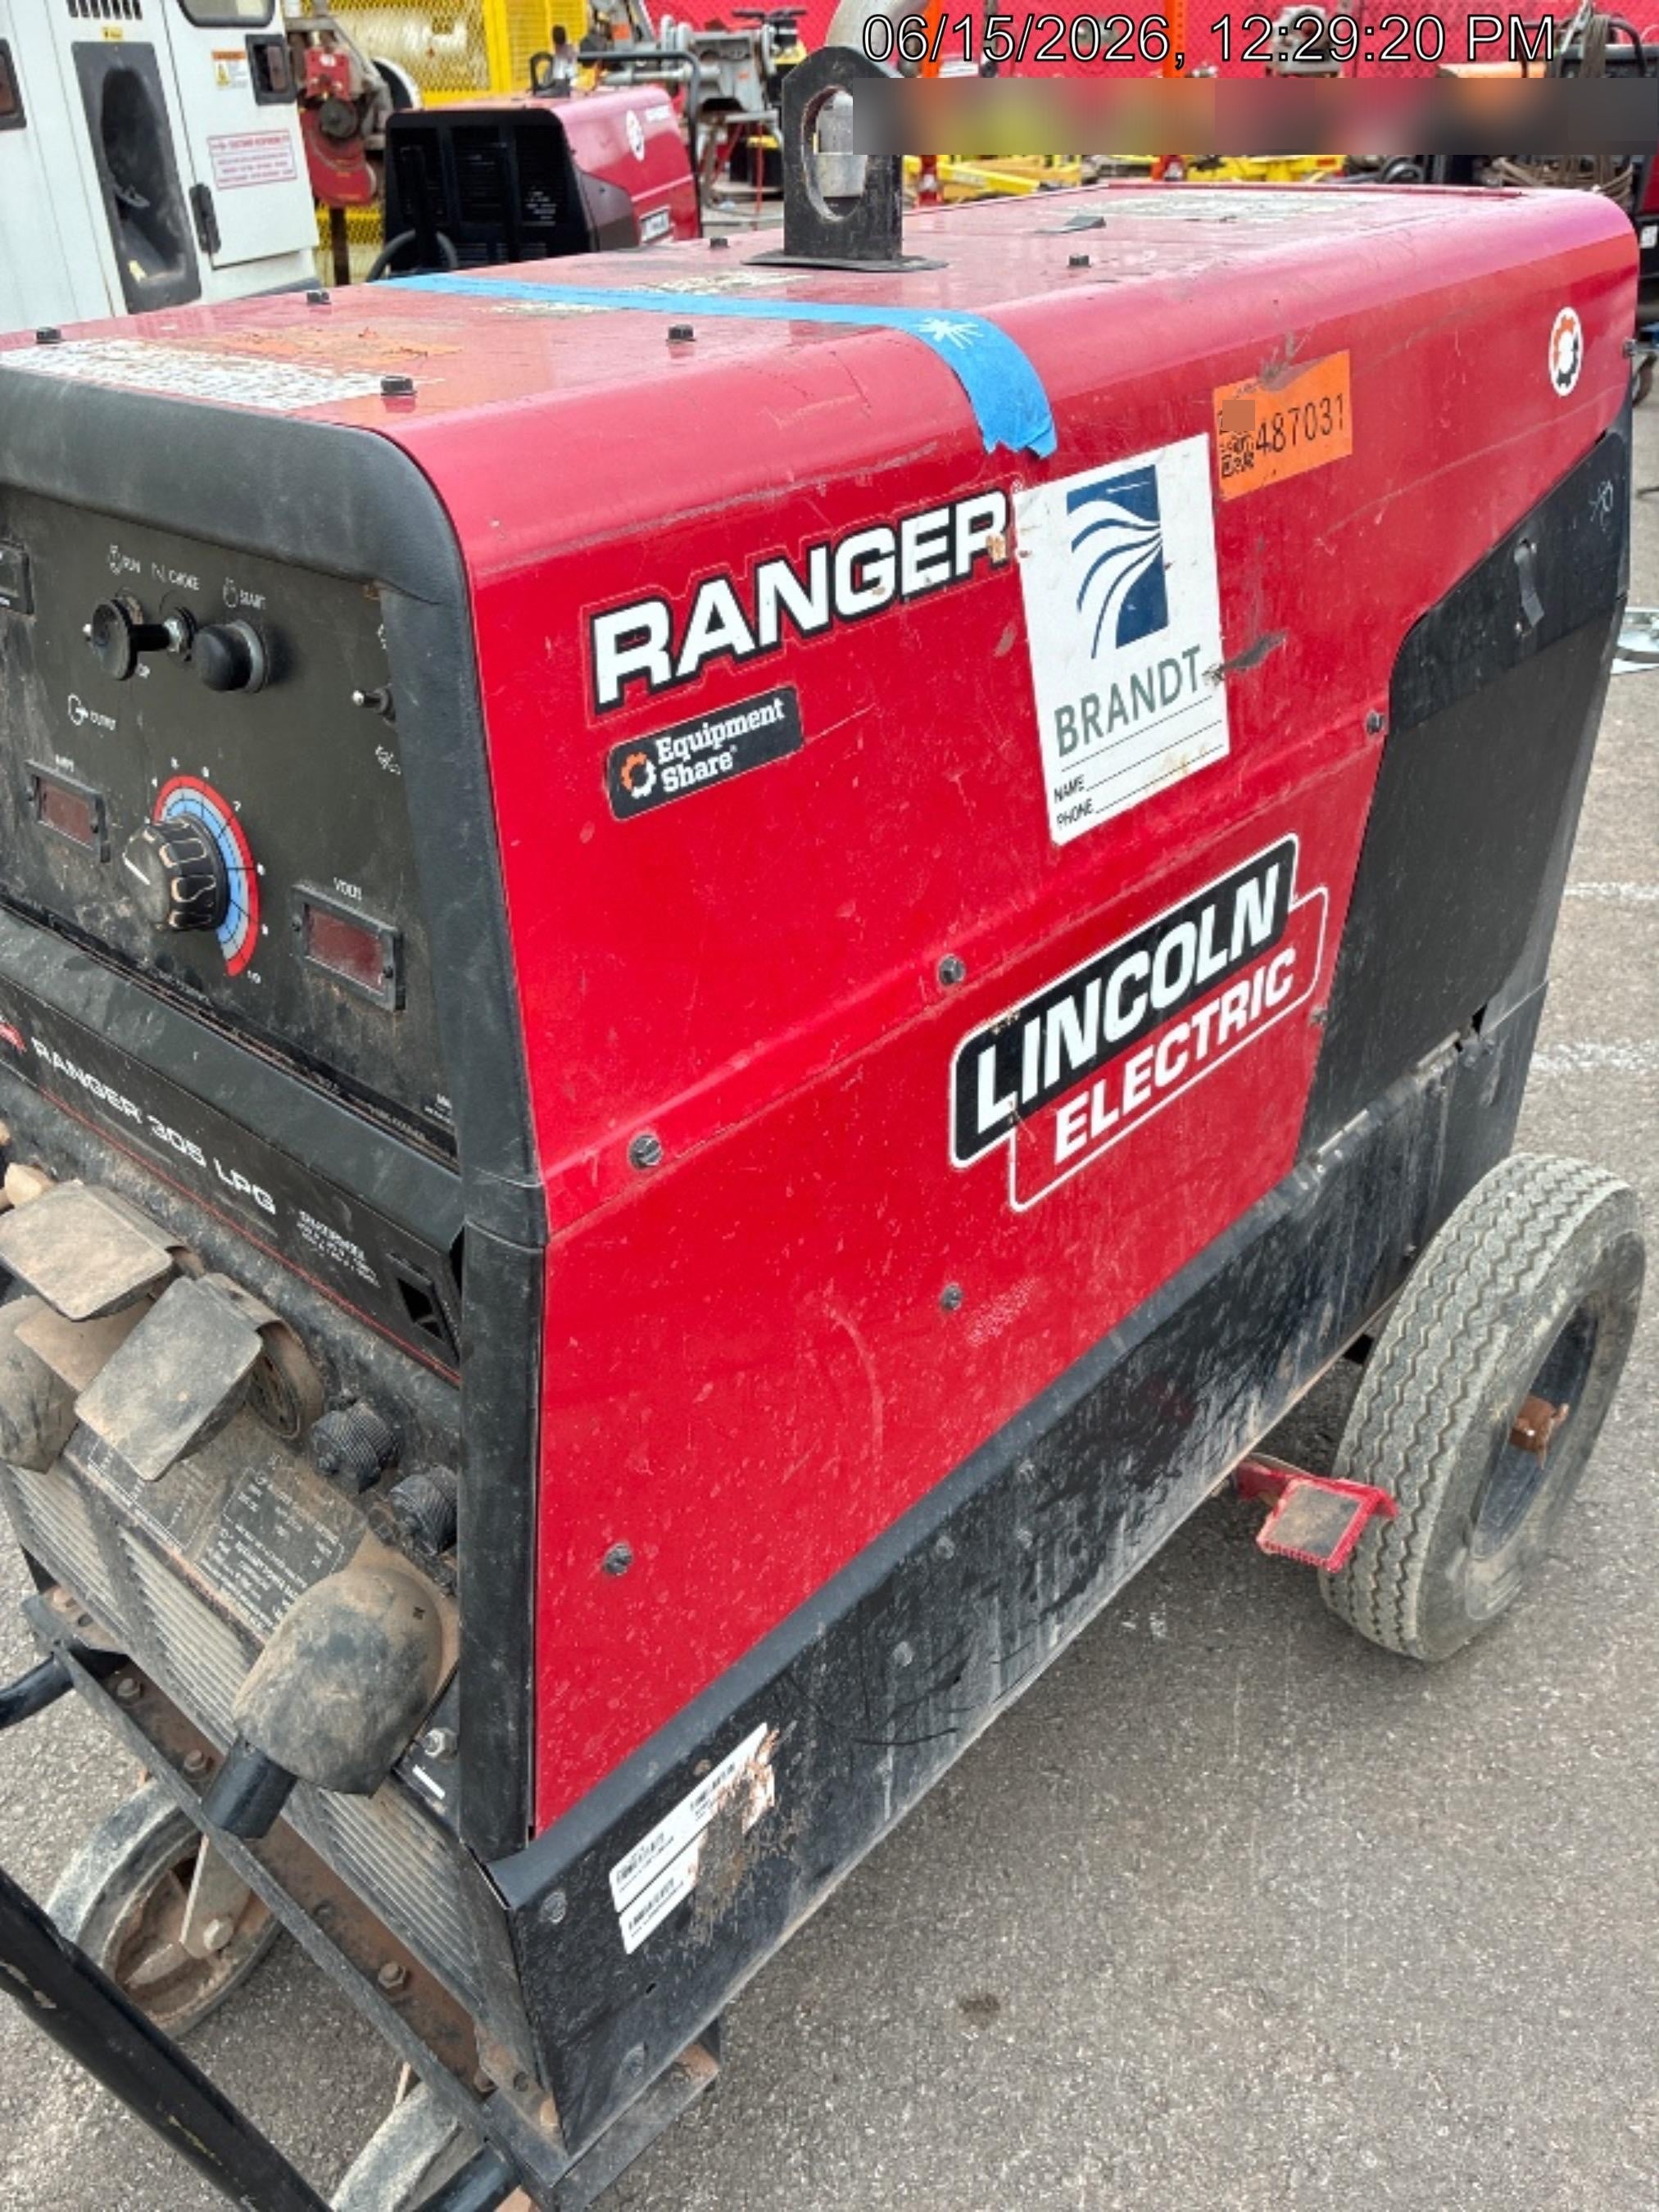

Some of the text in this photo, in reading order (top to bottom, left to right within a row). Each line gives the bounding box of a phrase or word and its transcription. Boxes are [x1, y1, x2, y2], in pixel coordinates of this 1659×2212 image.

[592, 490, 1009, 713] RANGER
[655, 697, 786, 765] Equipment
[1054, 645, 1202, 758] BRANDT
[660, 750, 734, 793] Share
[1054, 774, 1086, 804] NAME
[1056, 798, 1094, 830] PHONE
[977, 863, 1281, 1135] LINCOLN
[1054, 947, 1297, 1166] ELECTRIC
[30, 1036, 143, 1125] RANGER
[212, 1157, 277, 1215] LPG
